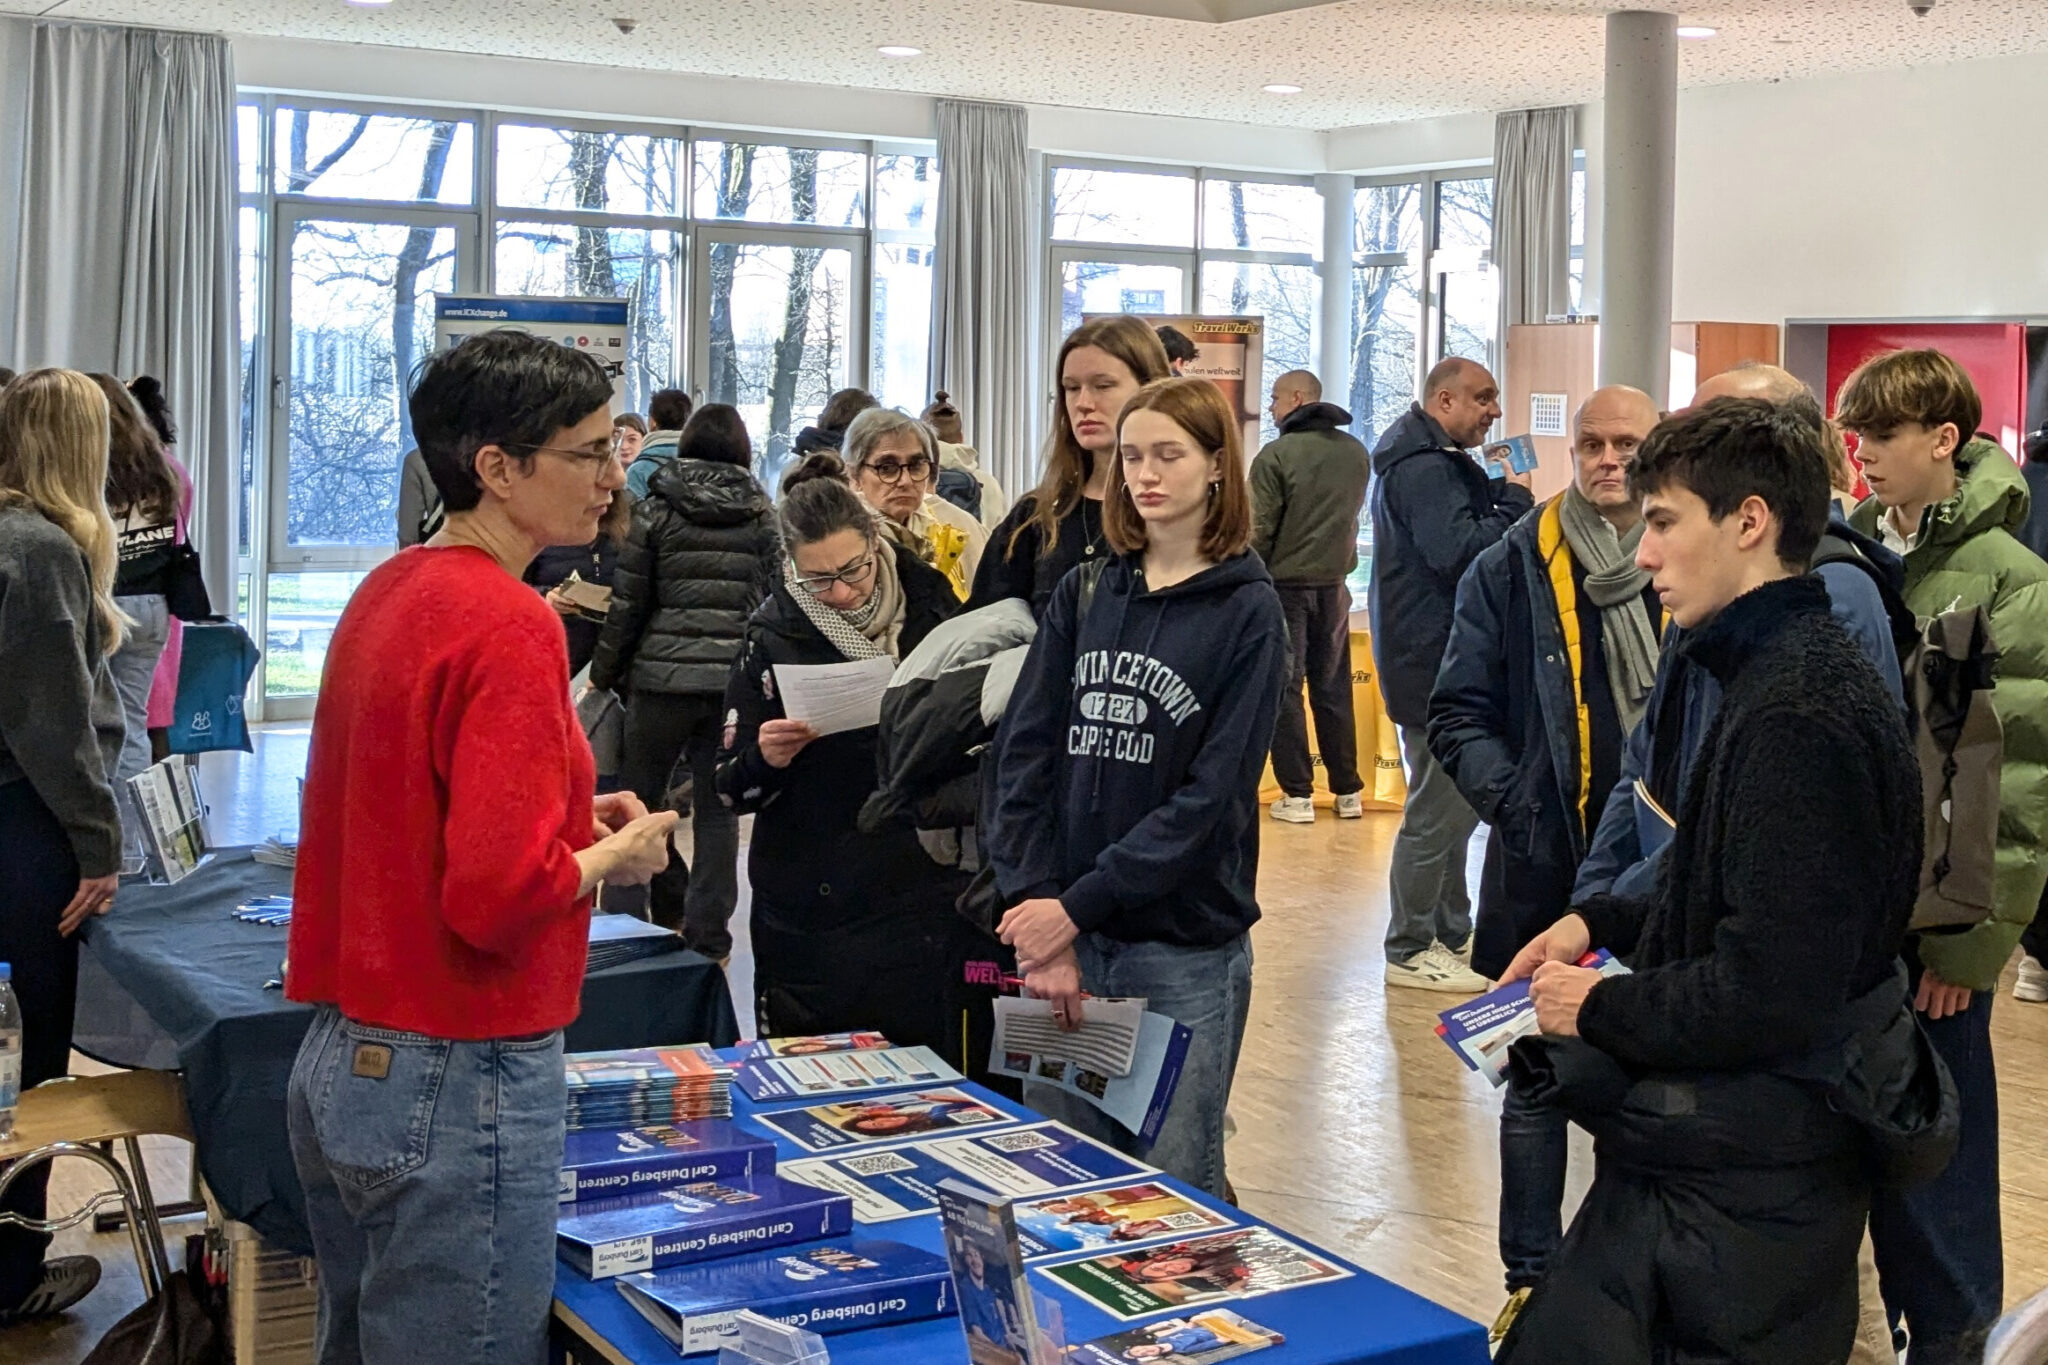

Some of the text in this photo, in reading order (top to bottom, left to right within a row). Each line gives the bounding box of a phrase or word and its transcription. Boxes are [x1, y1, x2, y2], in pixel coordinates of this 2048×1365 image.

[1195, 322, 1258, 333] TravelWorks
[1207, 366, 1241, 376] weltweit
[1068, 725, 1154, 764] CAPE COD
[1491, 1004, 1511, 1014] HIGH
[578, 1165, 717, 1188] Carl Duisberg Centren
[768, 1222, 794, 1237] Carl
[709, 1229, 767, 1246] Duisberg
[655, 1242, 706, 1256] Centren
[811, 1304, 876, 1322] Duisberg
[878, 1298, 906, 1314] Carl
